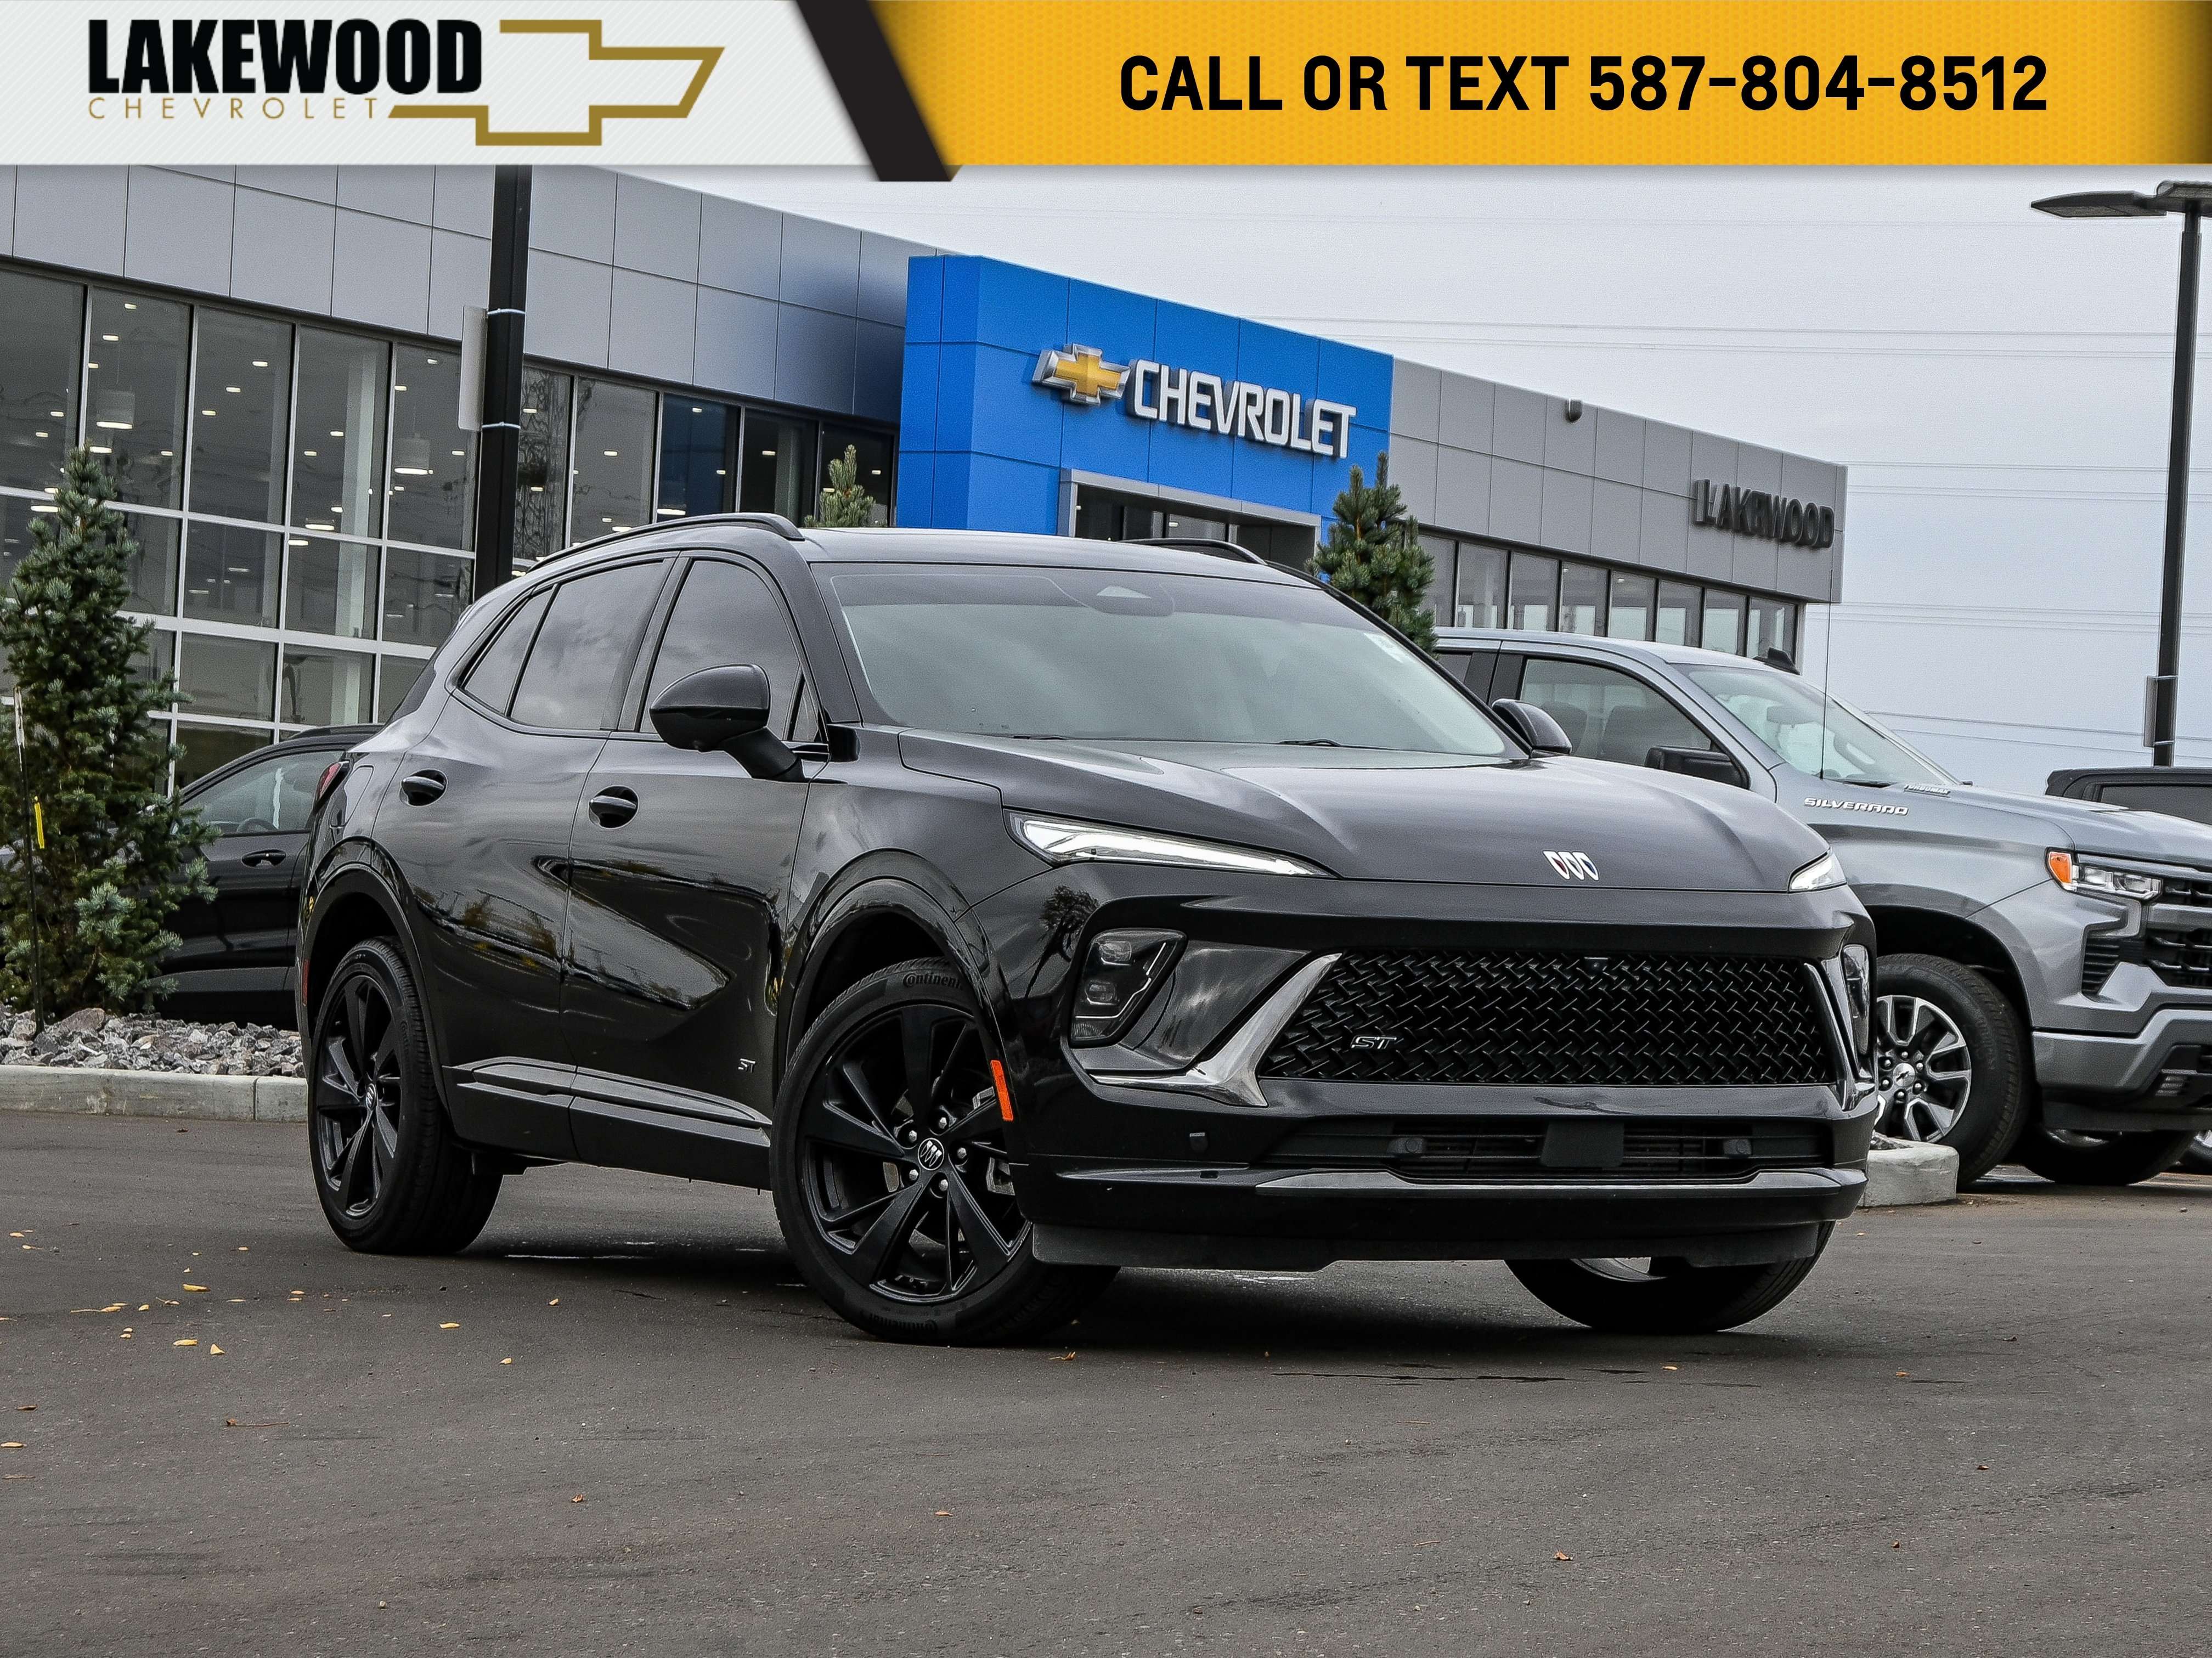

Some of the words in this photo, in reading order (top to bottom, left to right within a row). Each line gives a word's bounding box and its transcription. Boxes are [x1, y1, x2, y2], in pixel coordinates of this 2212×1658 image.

[1128, 359, 1357, 459] CHEVROLET
[1804, 797, 1909, 816] SILVERADO
[1350, 1035, 1397, 1050] ST
